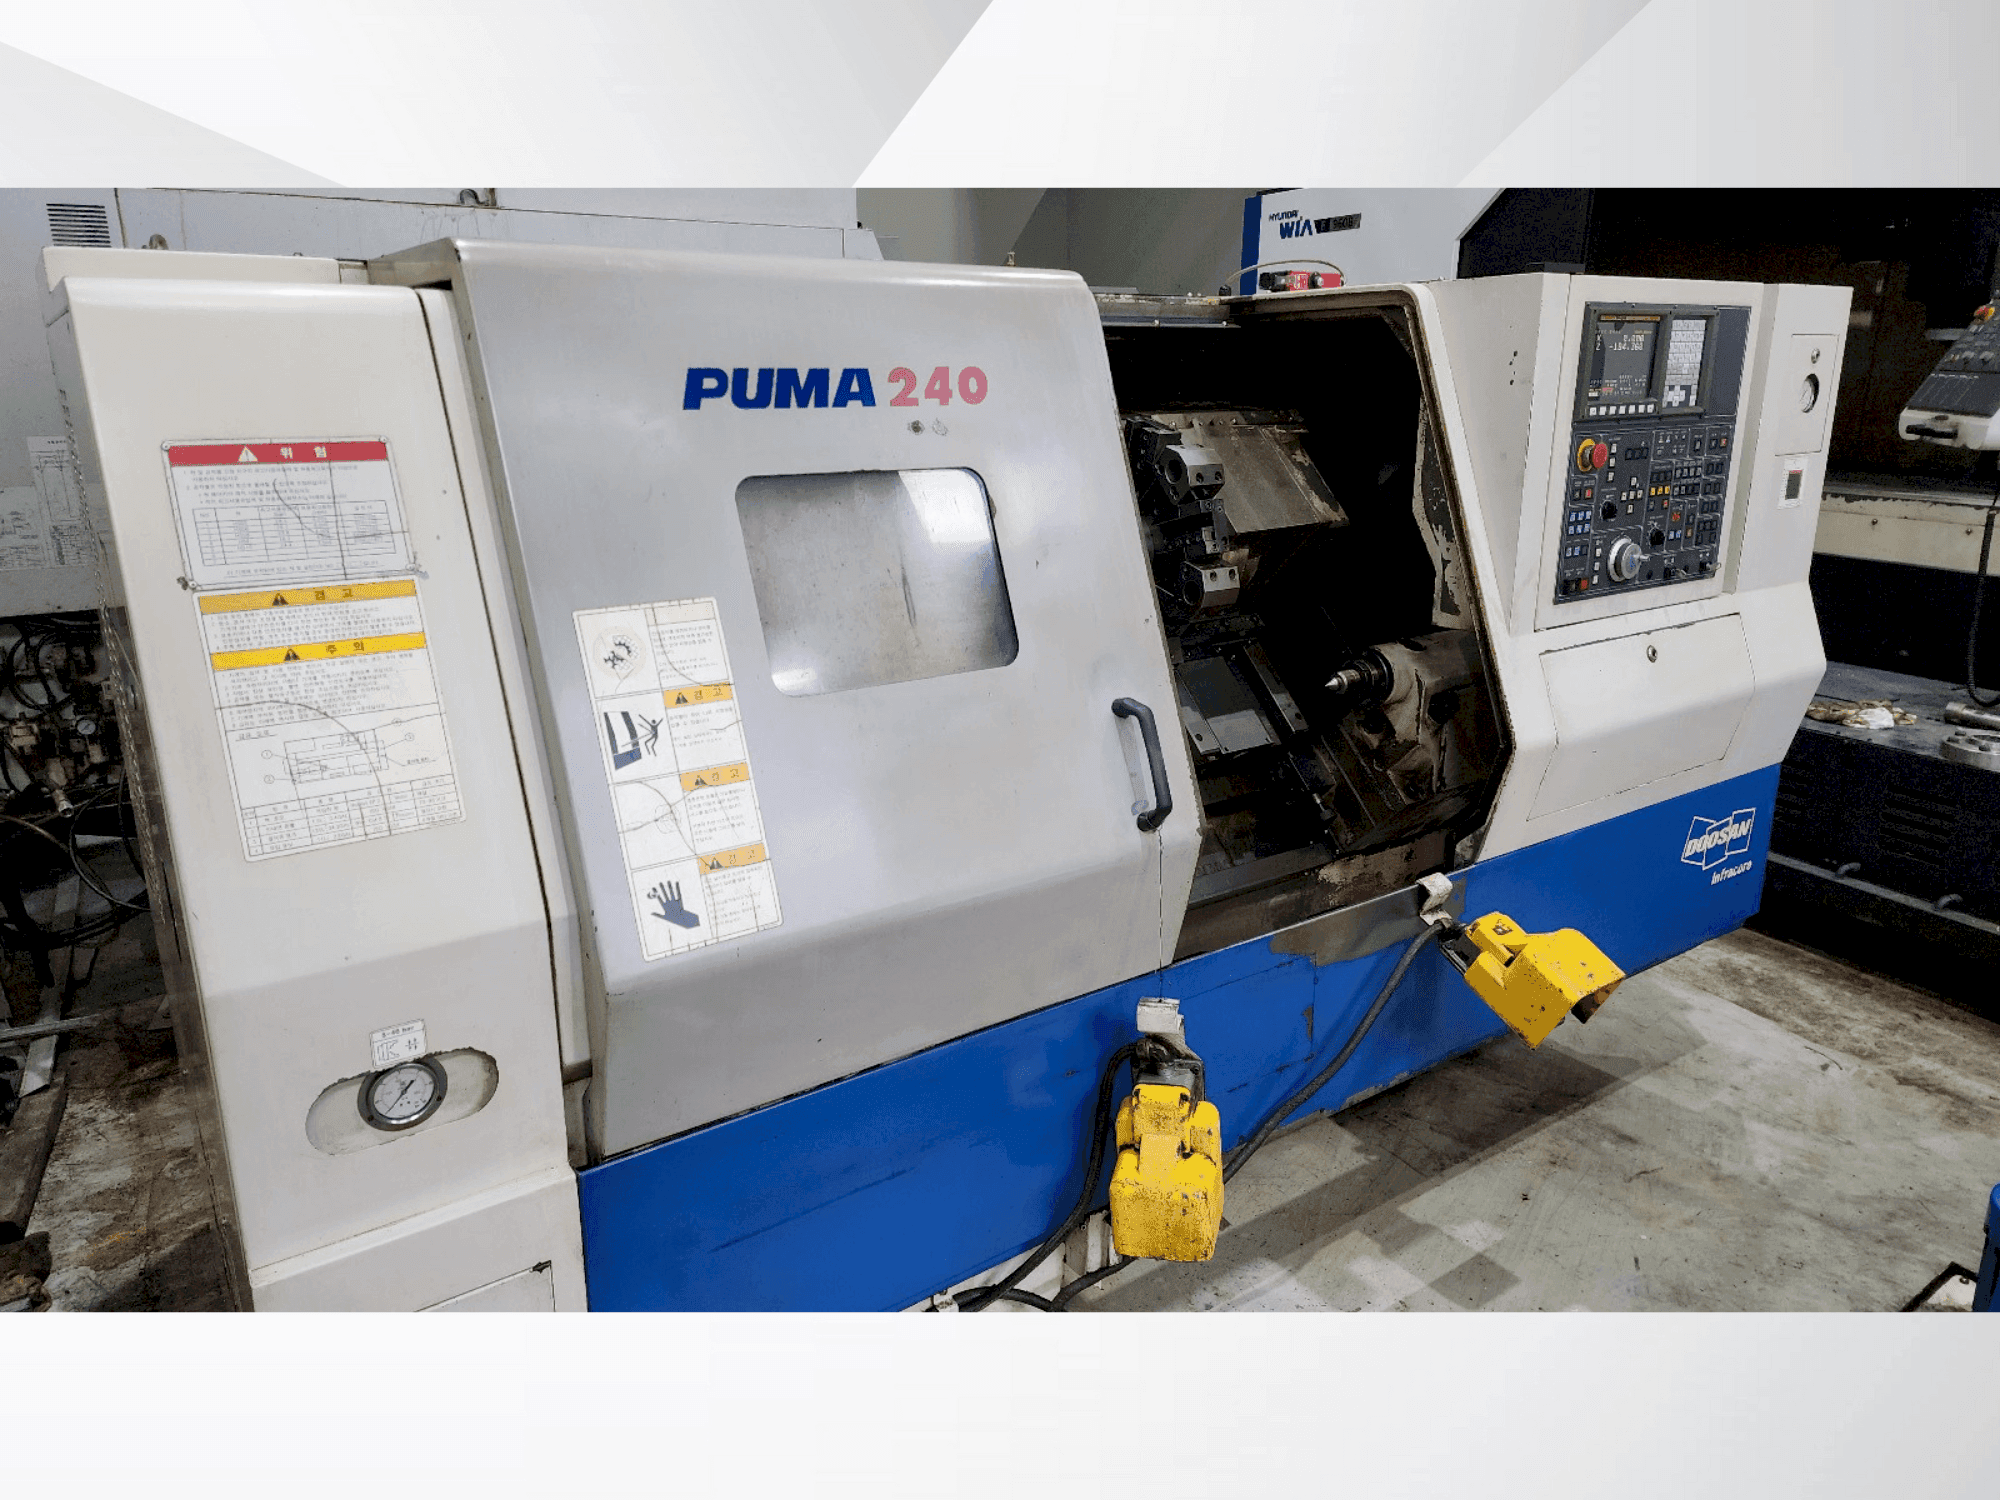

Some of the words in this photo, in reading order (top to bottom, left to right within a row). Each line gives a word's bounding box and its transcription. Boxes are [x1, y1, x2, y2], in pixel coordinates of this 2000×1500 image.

[683, 367, 876, 410] PUMA
[888, 366, 988, 407] 240
[1683, 818, 1752, 858] DOOSAN
